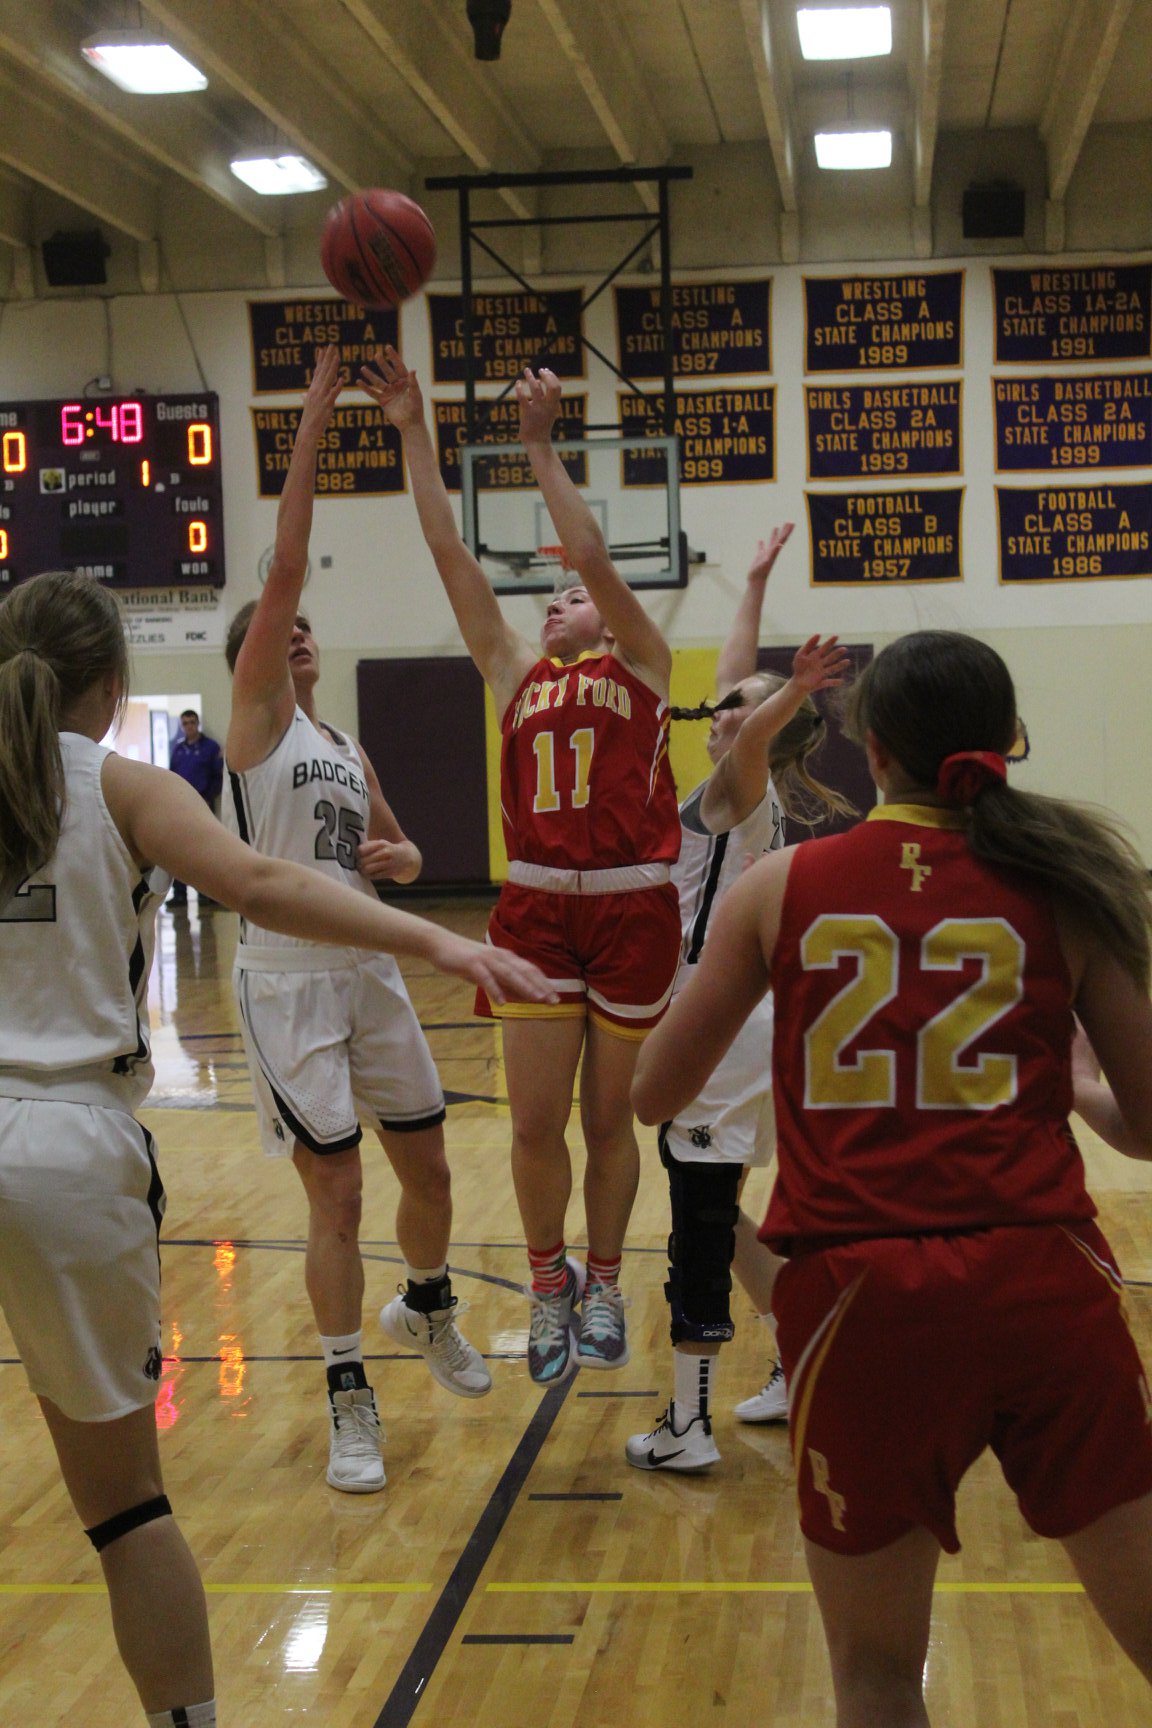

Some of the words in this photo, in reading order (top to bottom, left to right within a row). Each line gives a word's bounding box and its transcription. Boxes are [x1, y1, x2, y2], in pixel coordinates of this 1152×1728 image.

[842, 279, 926, 300] WRESTLING
[1030, 272, 1115, 292] WRESTLING
[651, 286, 735, 307] WESTLING
[1005, 295, 1071, 315] CLASS
[1085, 291, 1141, 312] 1A-2A
[284, 303, 365, 323] WRESTLING
[731, 307, 743, 326] A
[836, 302, 903, 323] CLASS
[918, 301, 930, 319] A
[275, 324, 340, 345] CLASS
[363, 323, 375, 341] A
[455, 317, 520, 337] CASS
[545, 316, 557, 334] A
[814, 326, 857, 346] STATE
[871, 321, 954, 343] CHAMPIONS
[1003, 318, 1046, 336] STATE
[1059, 314, 1144, 335] CHAMPIONS
[439, 340, 482, 358] STAE
[682, 329, 763, 350] CHAMPIONS
[1051, 337, 1095, 357] 1991
[260, 347, 302, 366] STATE
[672, 352, 719, 373] 1987
[859, 345, 908, 365] 1989
[809, 391, 851, 409] GIRLS
[864, 387, 958, 408] BASKETBALL
[997, 383, 1040, 401] GIRLS
[1055, 378, 1152, 401] BASKETBALL
[156, 402, 208, 420] Guests
[677, 392, 771, 415] BASKETBALL
[1017, 403, 1088, 423] CLASS
[1104, 401, 1132, 421] 2A
[61, 402, 143, 445] 6:48
[256, 412, 298, 430] GIRLS
[831, 411, 896, 431] CLASS
[911, 409, 936, 428] 2A
[275, 431, 341, 450] CLSS
[816, 433, 858, 452] STATE
[872, 429, 953, 450] CHAMPIONS
[1005, 426, 1049, 445] STATE
[1064, 422, 1146, 443] CHAMPIONS
[2, 431, 26, 473] 0
[187, 423, 212, 466] 0
[685, 436, 766, 457] CHAMPIONS
[1051, 445, 1100, 465] 1999
[265, 453, 292, 471] STA
[318, 449, 396, 469] CHAMPIONS
[680, 459, 723, 478] 989
[861, 452, 909, 472] 1993
[69, 469, 116, 489] period
[141, 459, 150, 487] 1
[316, 472, 355, 491] 982
[69, 499, 116, 518] player
[175, 497, 209, 512] fouls
[847, 495, 923, 515] FOOTBALL
[1038, 490, 1116, 511] FOOTBALL
[834, 517, 901, 537] CLASS
[924, 514, 938, 534] B
[1024, 512, 1093, 533] CLASS
[1118, 510, 1131, 530] A
[188, 521, 207, 553] 0
[819, 539, 861, 558] STATE
[874, 535, 953, 557] CHAMPIONS
[1008, 536, 1052, 555] STATE
[1067, 531, 1149, 553] CHAMPIONS
[181, 562, 208, 575] won
[863, 559, 911, 578] 1957
[1052, 555, 1102, 576] 1986
[122, 590, 173, 605] ational
[180, 589, 218, 603] Bank
[576, 673, 631, 721] FORD
[532, 727, 594, 813] 11
[314, 799, 365, 871] 25
[800, 913, 1026, 1110] 22
